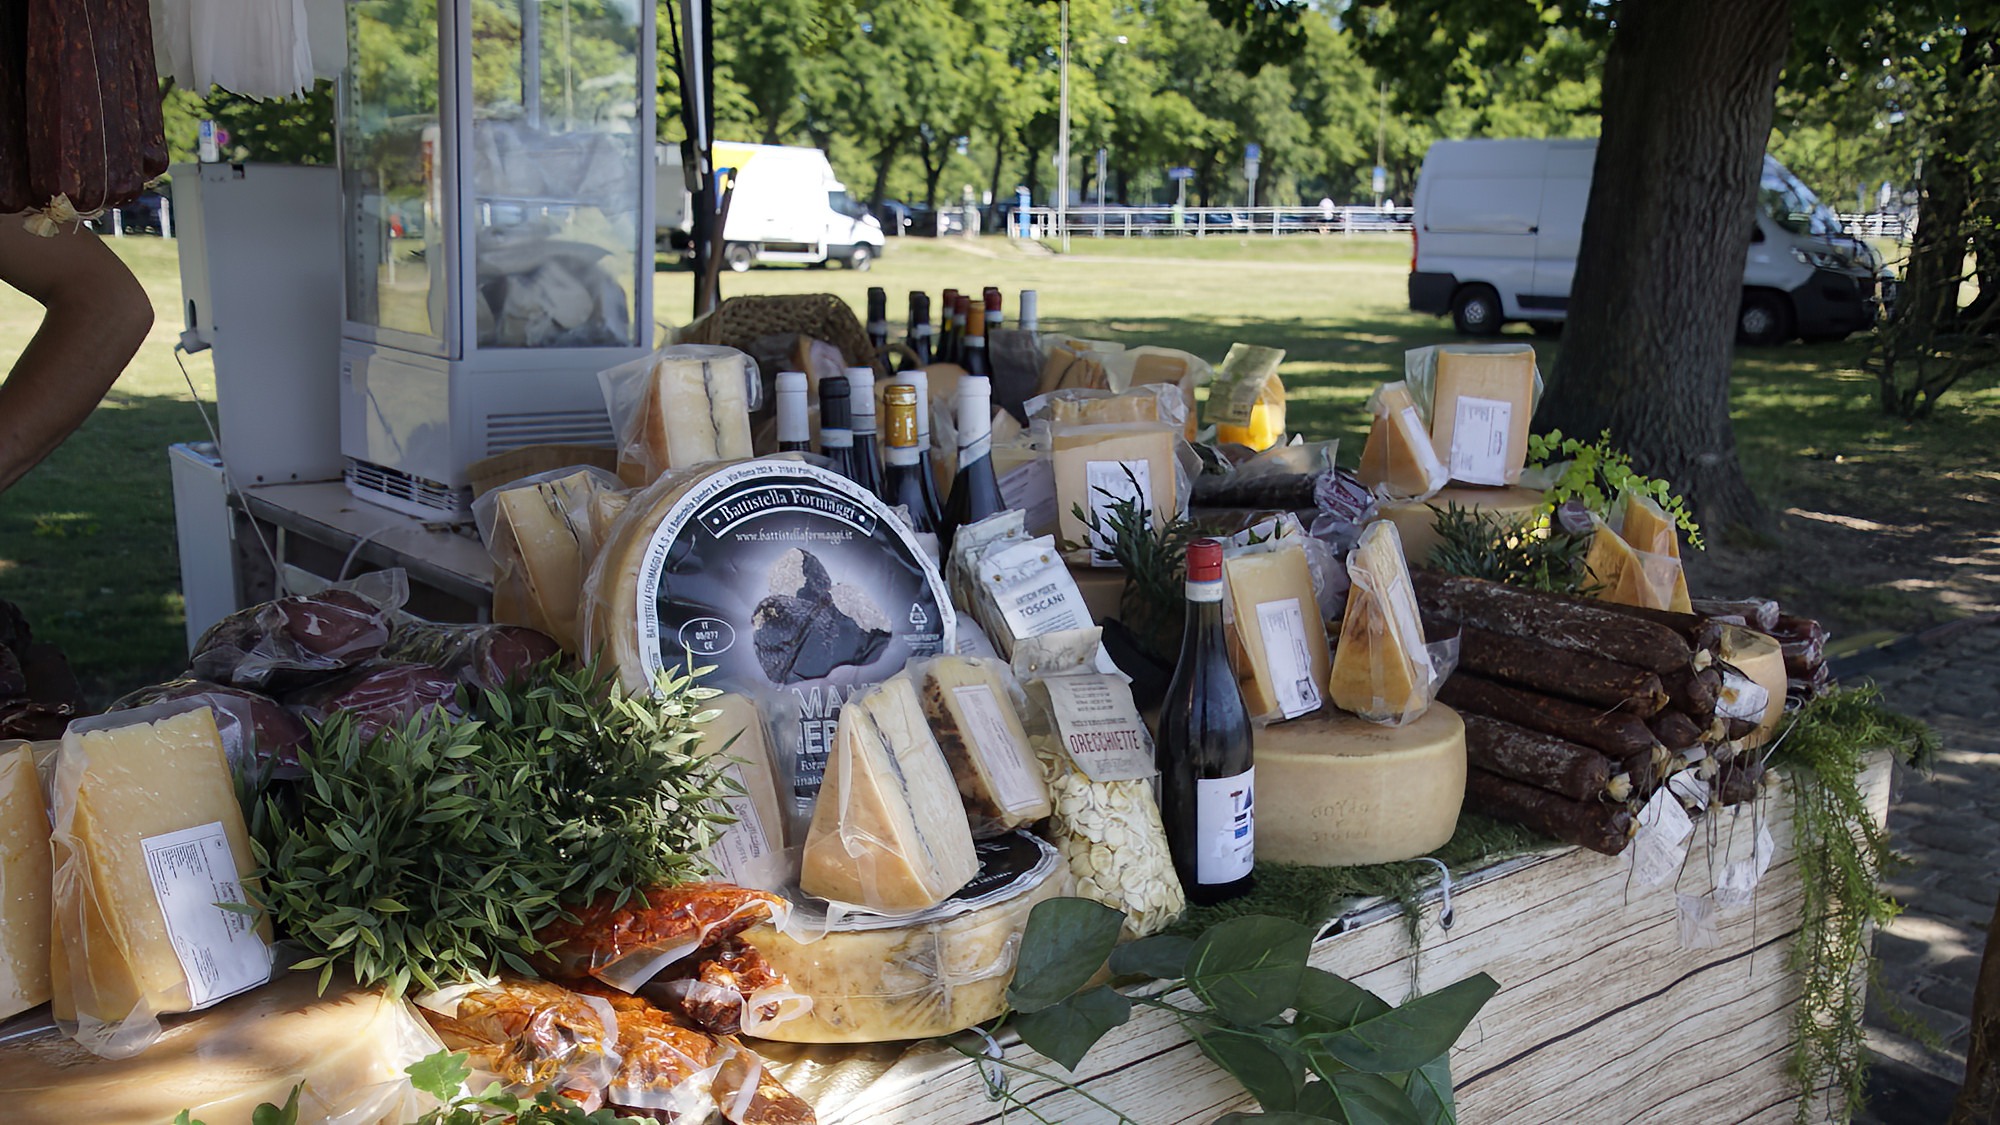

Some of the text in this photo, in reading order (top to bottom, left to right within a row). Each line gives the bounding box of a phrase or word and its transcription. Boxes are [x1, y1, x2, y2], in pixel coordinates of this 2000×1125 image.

[719, 489, 788, 522] Battistella
[791, 489, 856, 520] Formaggi
[735, 527, 854, 545] www.battistellaformaggi.it
[1019, 593, 1065, 617] TOSCANI
[701, 621, 709, 630] IT
[1069, 730, 1140, 754] ORECCHIETTE
